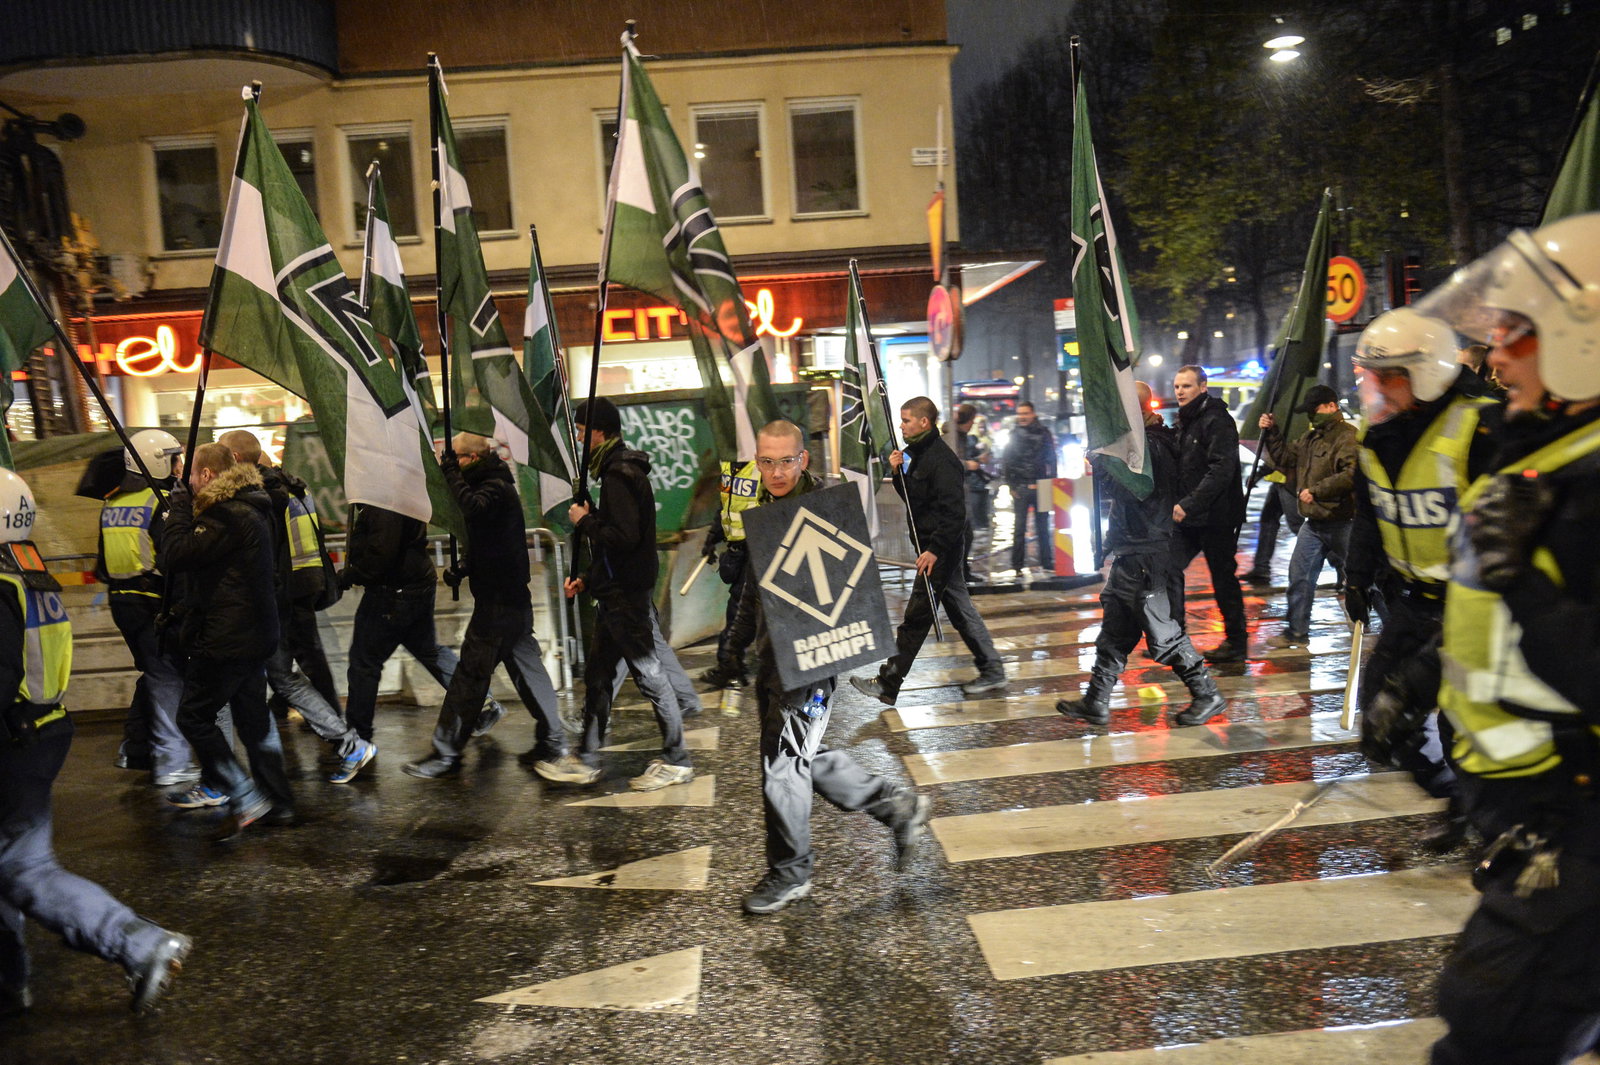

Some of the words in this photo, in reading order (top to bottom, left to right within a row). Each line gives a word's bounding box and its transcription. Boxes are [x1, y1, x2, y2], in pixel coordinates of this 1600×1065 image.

[1327, 272, 1356, 306] 50
[19, 495, 29, 511] A
[102, 507, 145, 526] POLIS
[793, 620, 872, 653] RADIKAL
[796, 633, 876, 671] KAMP!
